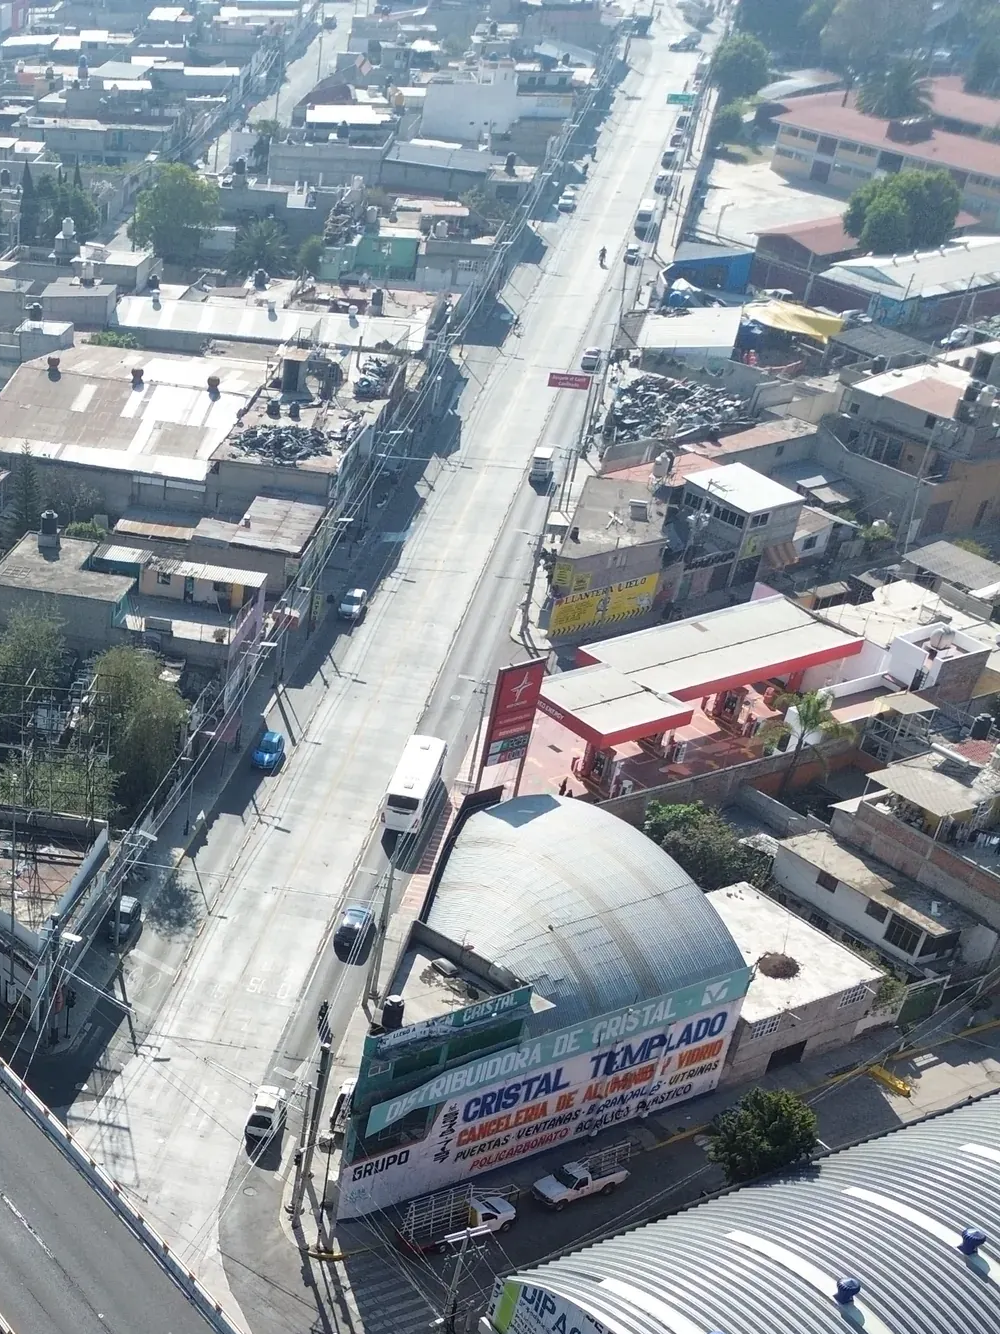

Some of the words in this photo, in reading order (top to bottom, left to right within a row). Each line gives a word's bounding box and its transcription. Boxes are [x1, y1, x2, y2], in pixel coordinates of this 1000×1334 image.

[463, 993, 517, 1023] CRISTAL
[385, 1041, 541, 1122] DISTRIBUIDORA
[552, 1028, 583, 1058] DE
[592, 998, 676, 1044] CRISTAL
[462, 1066, 570, 1123] CRISTAL
[591, 1011, 728, 1080] TEMPLADO
[456, 1100, 549, 1147] CANCELERIA
[555, 1088, 580, 1113] DE
[676, 1039, 724, 1068] VIDRIO
[352, 1150, 410, 1182] GRUPO
[455, 1134, 511, 1162] PUERTAS
[469, 1127, 571, 1171] POLICARBONATO
